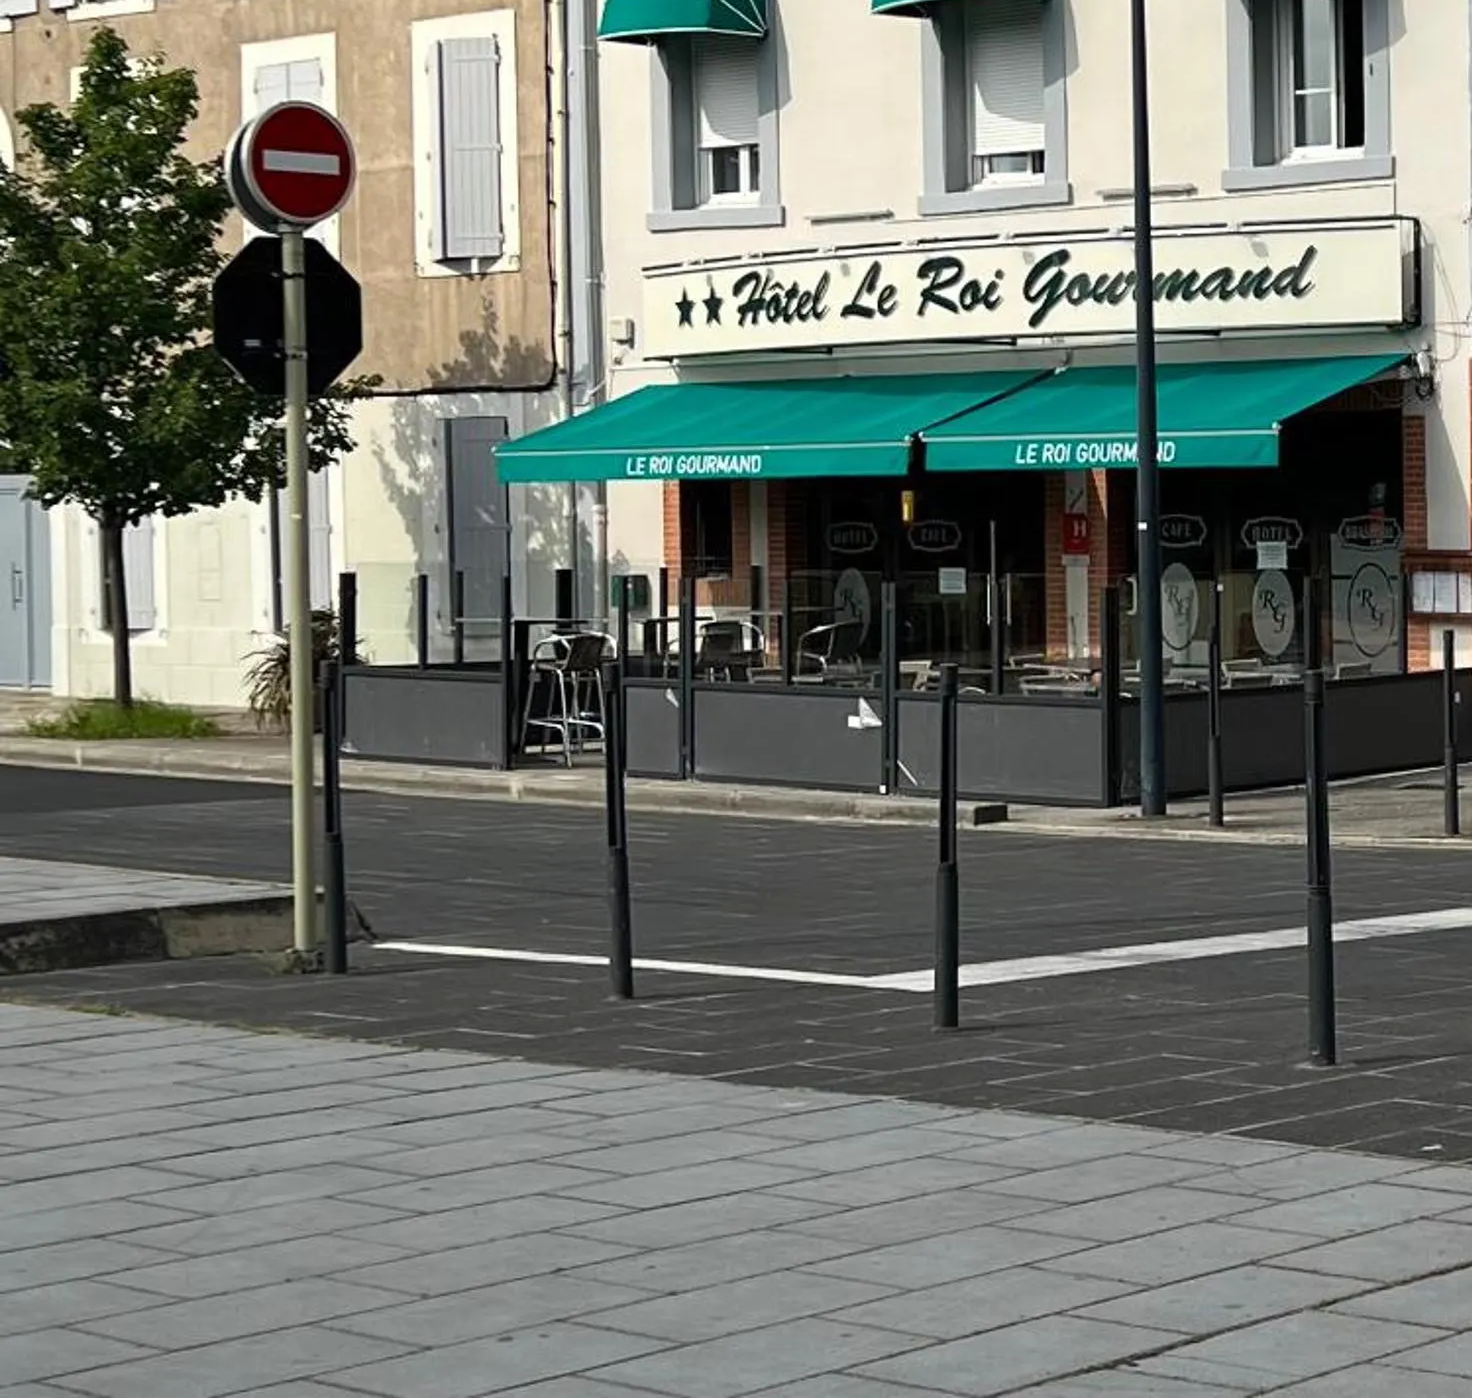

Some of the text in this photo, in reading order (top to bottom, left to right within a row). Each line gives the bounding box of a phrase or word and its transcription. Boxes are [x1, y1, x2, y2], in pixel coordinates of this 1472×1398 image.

[732, 269, 831, 327] Hôtel
[840, 260, 899, 319] Le
[917, 256, 1005, 316] Roi
[1015, 441, 1176, 464] LE ROI GOURMND
[626, 454, 762, 476] LE ROI GOURMAND
[1073, 519, 1087, 537] H
